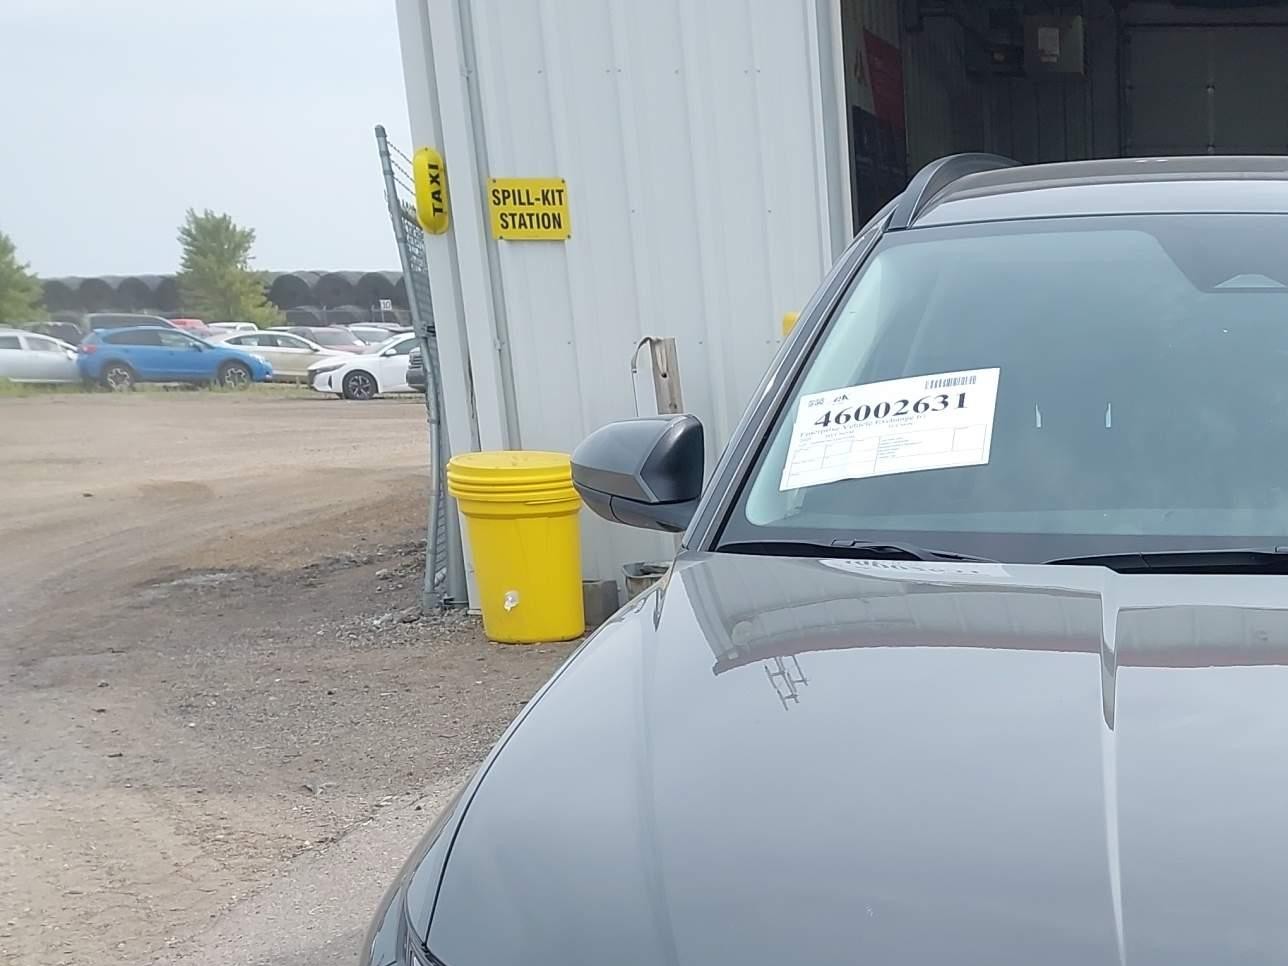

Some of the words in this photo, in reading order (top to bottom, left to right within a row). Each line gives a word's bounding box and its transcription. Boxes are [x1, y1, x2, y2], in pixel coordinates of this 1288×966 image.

[428, 163, 444, 217] TAXI
[491, 188, 565, 206] SPILL-KIT
[499, 212, 563, 230] STATION
[813, 391, 968, 427] 46002631
